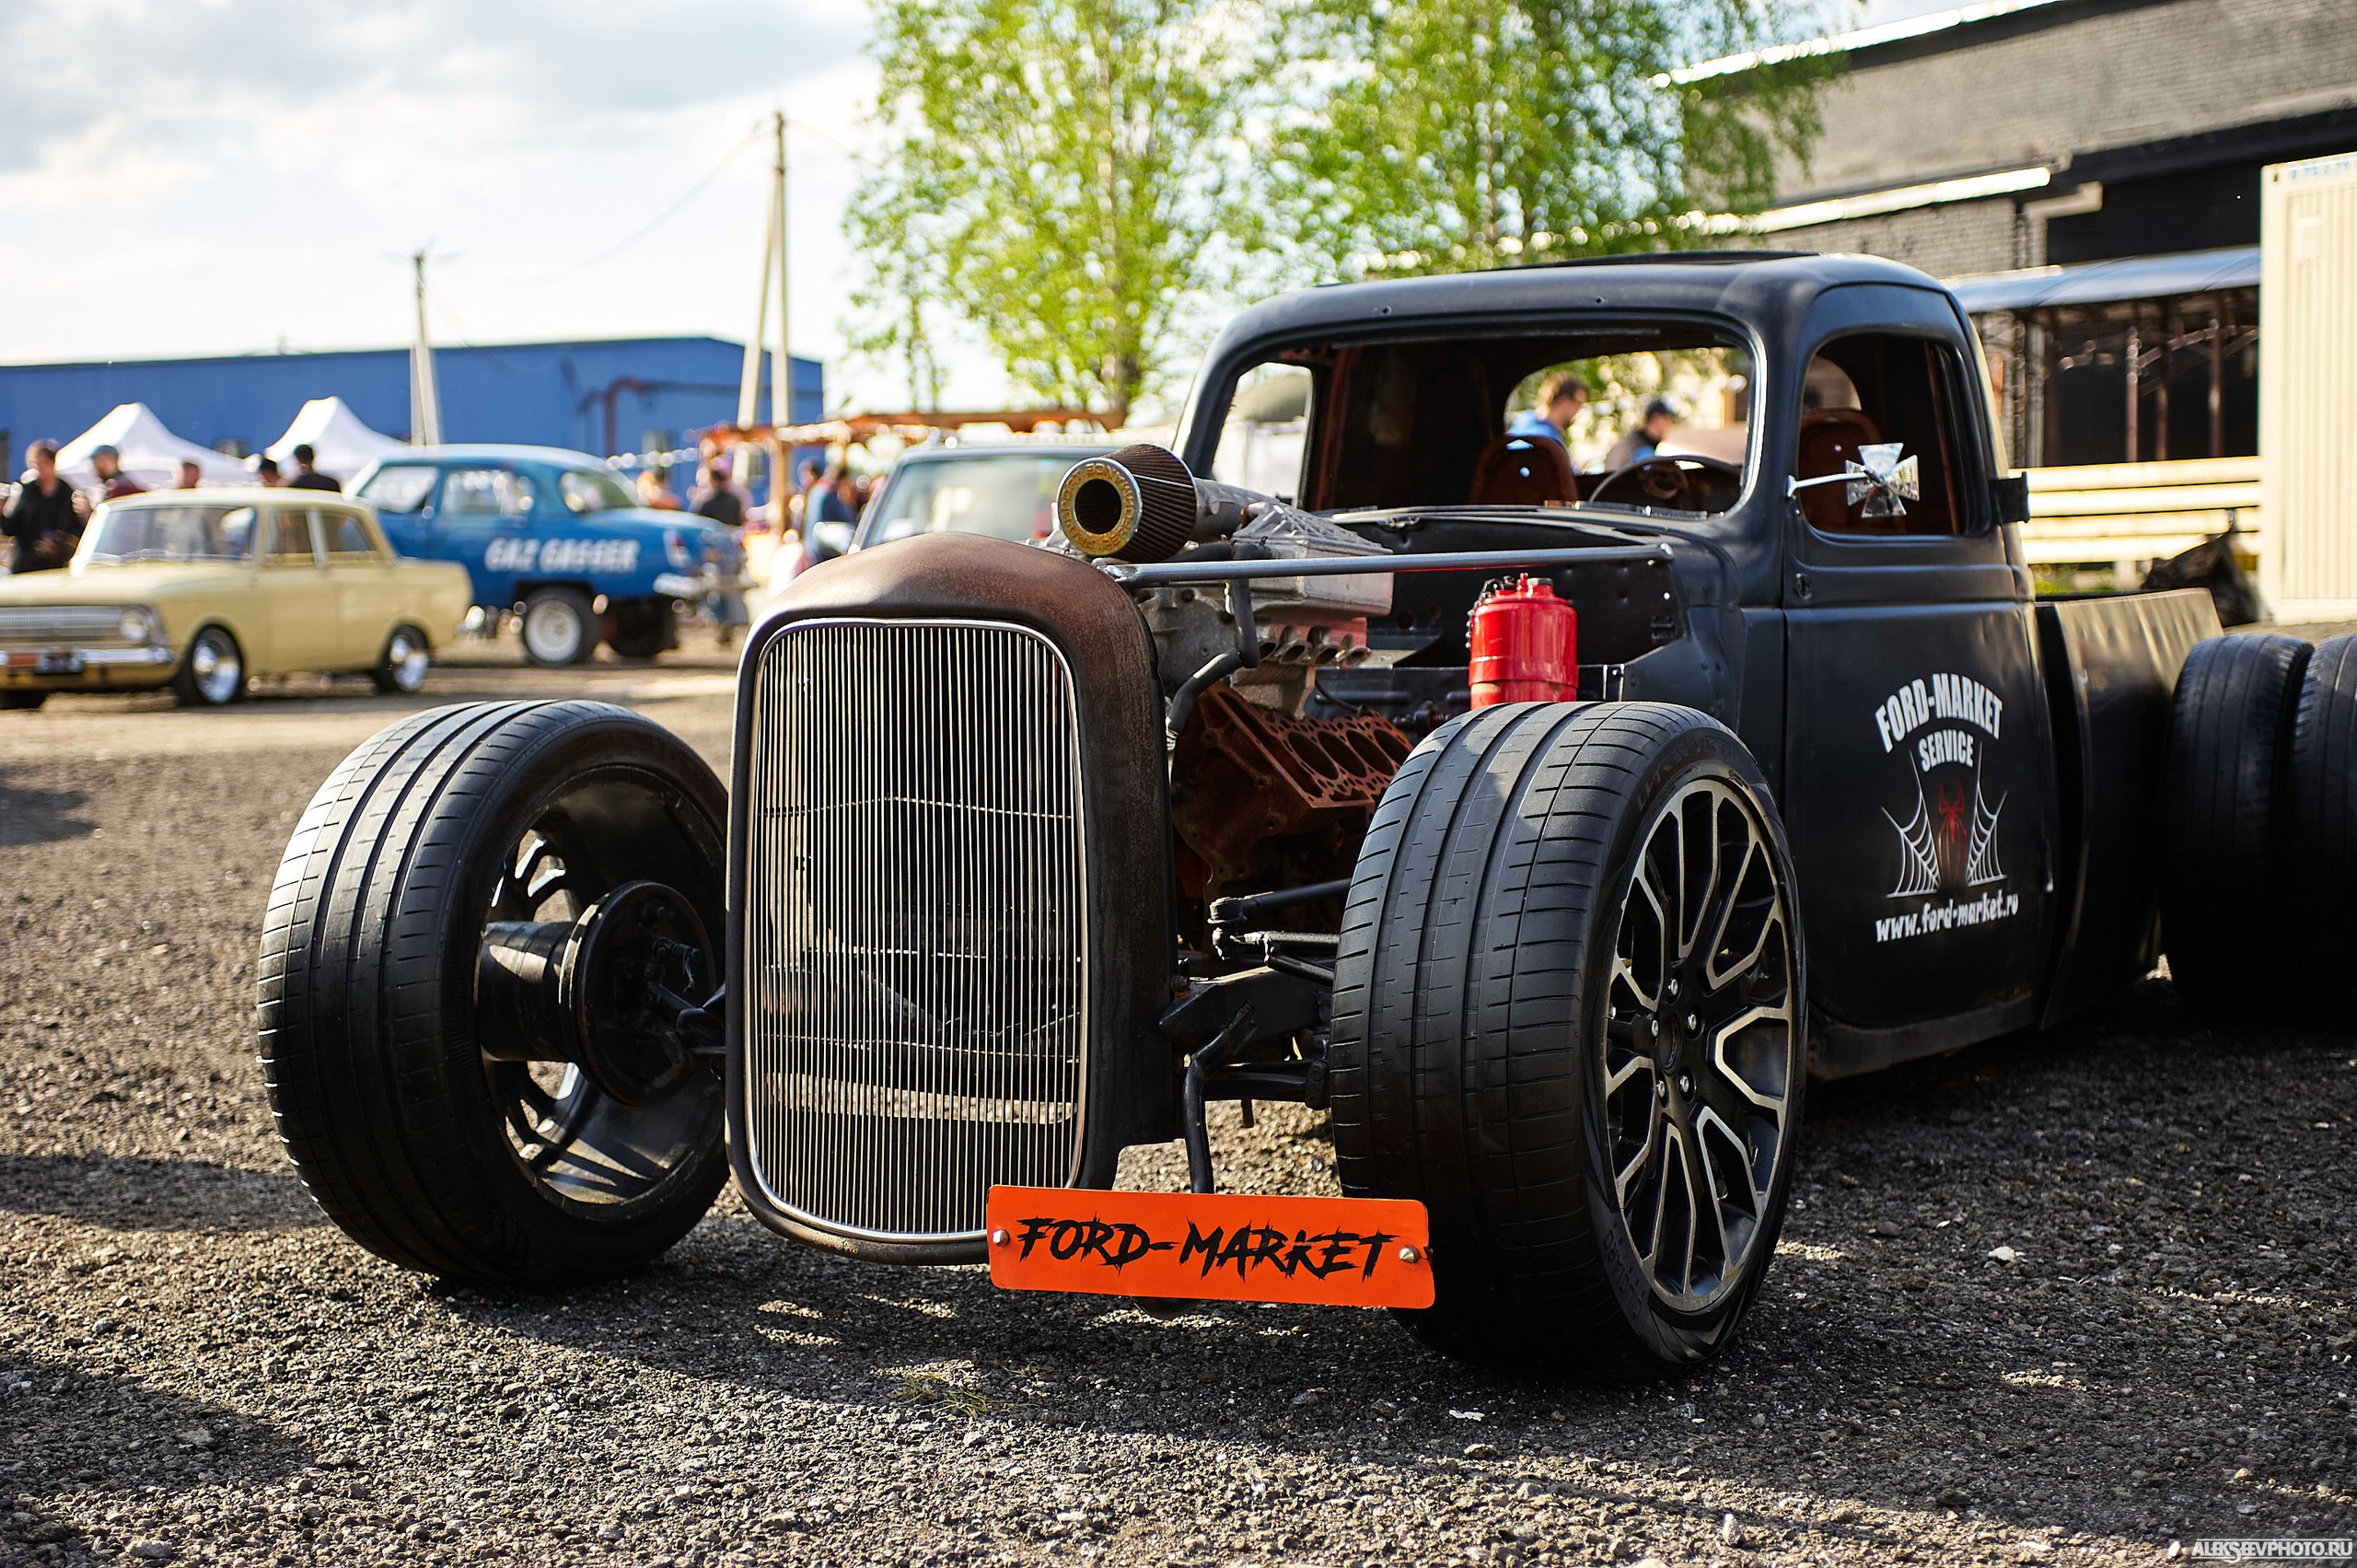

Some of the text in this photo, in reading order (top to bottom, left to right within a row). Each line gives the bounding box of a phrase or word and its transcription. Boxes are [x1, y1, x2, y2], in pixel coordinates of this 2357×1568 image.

[1875, 673, 2003, 752] FORD-MARKET
[1918, 729, 1974, 772] SERVICE
[1875, 889, 2019, 943] www.ford-market.ru
[1016, 1211, 1400, 1283] FORD-MARKET
